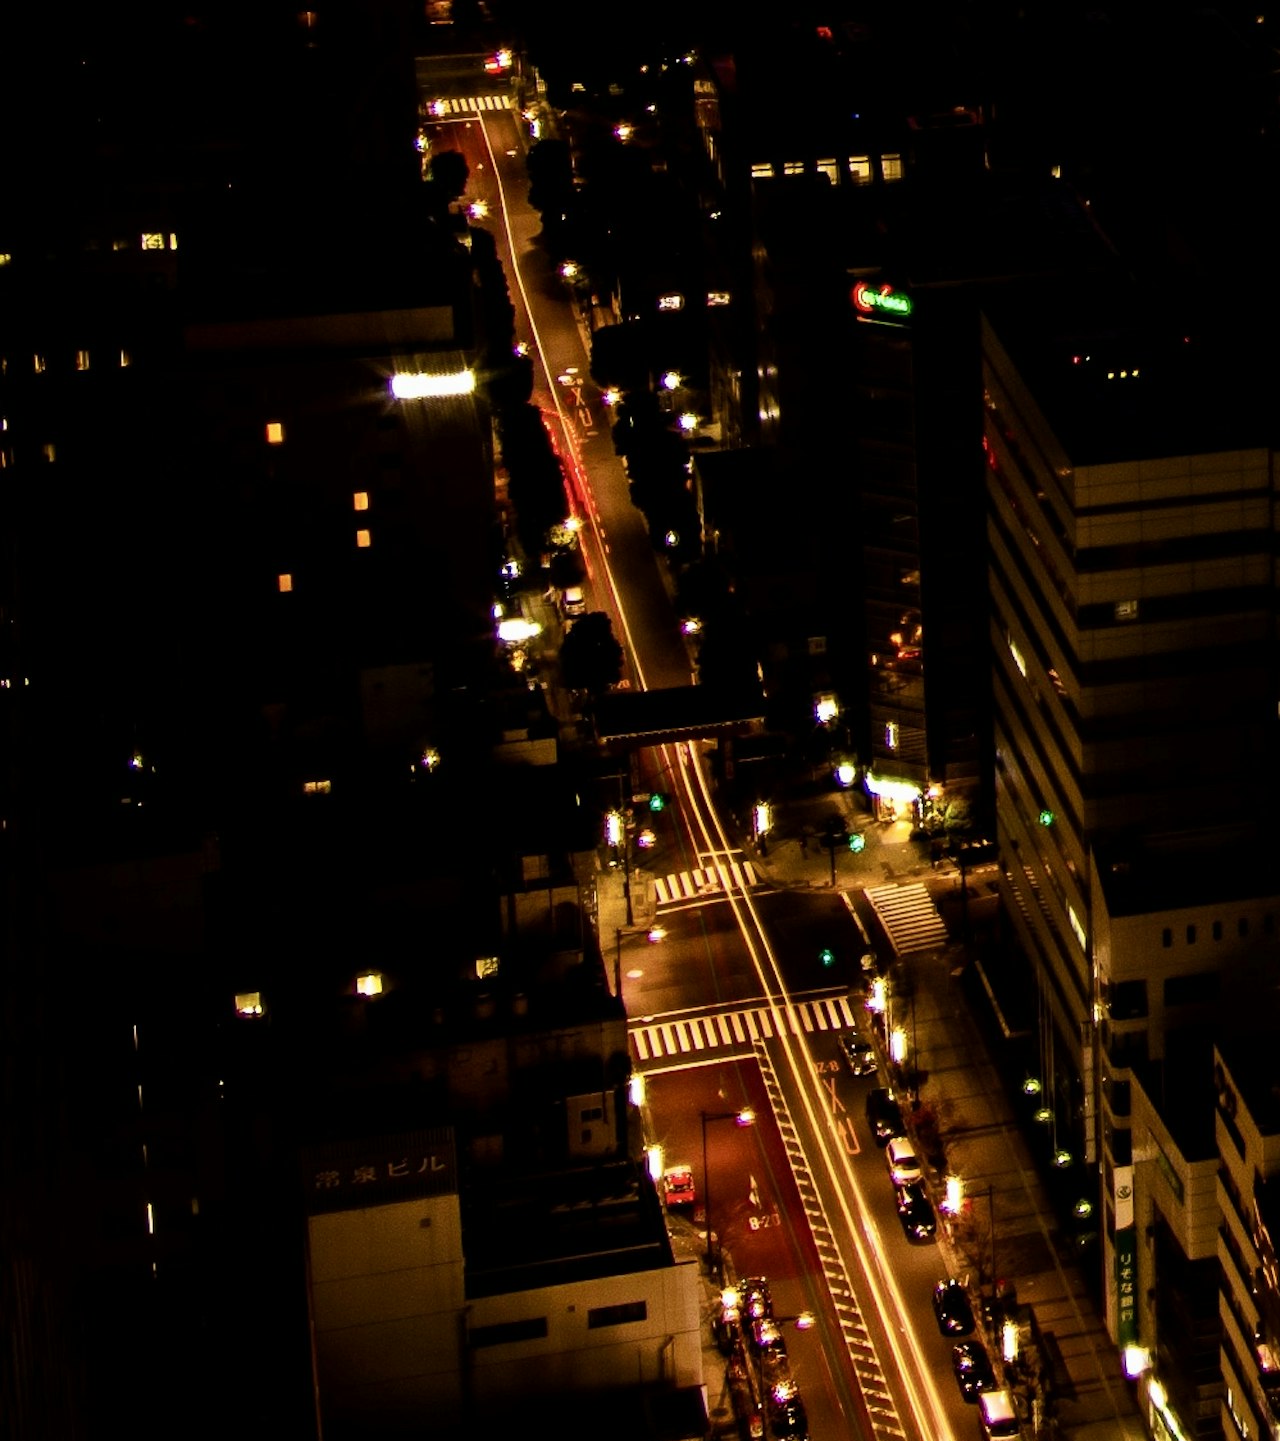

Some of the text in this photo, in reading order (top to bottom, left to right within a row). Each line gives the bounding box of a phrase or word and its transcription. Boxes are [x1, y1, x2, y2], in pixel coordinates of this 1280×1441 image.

[1120, 1253, 1134, 1321] りそな銀行
